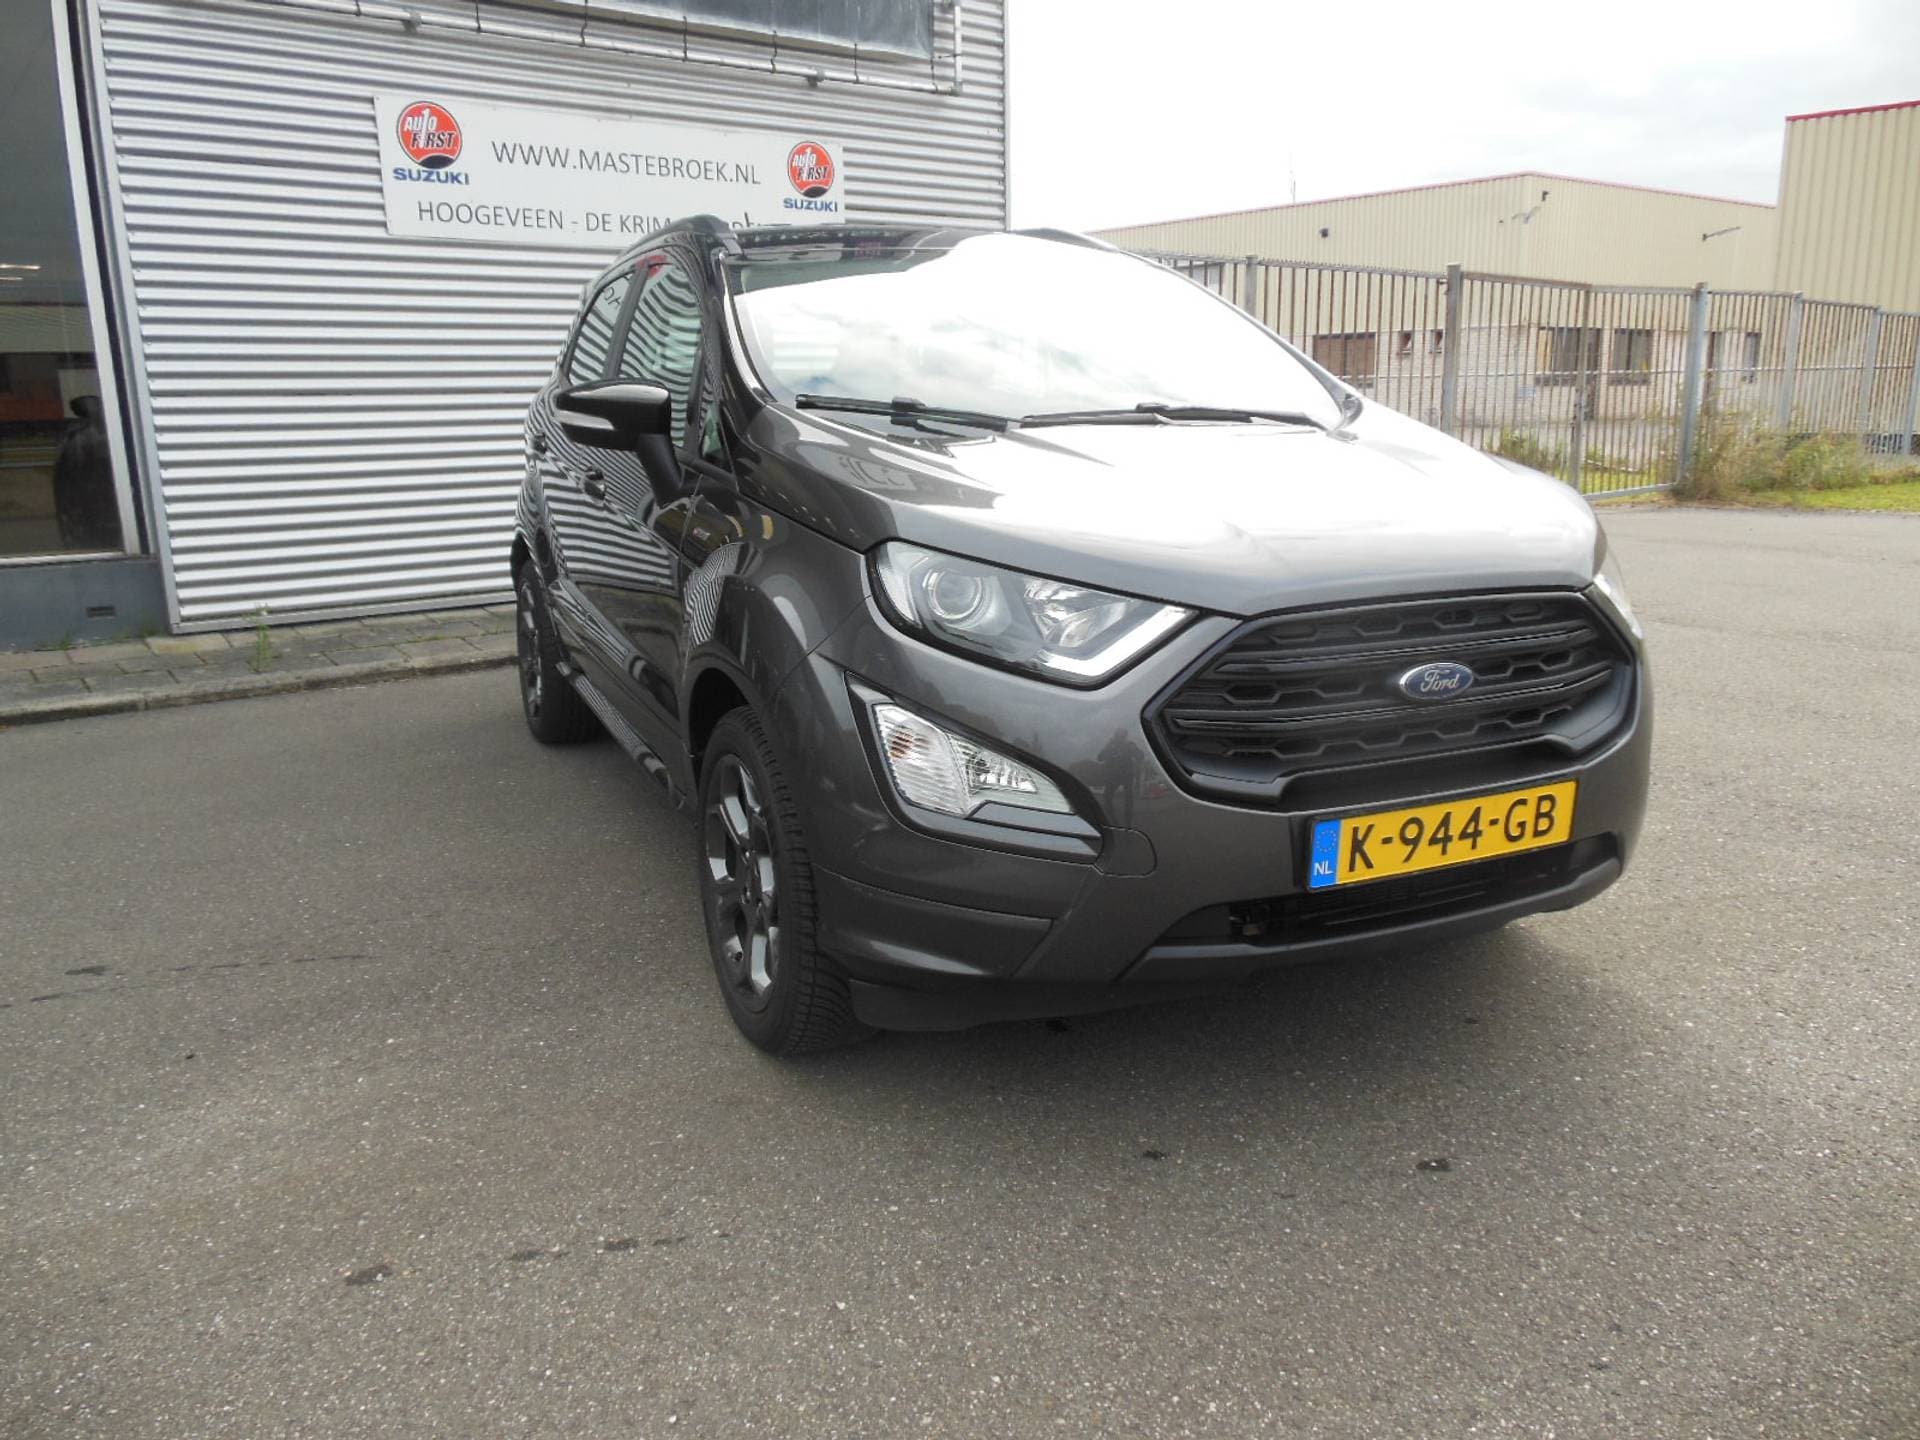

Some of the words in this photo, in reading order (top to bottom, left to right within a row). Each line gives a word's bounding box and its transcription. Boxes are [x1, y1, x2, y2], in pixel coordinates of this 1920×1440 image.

[491, 140, 762, 185] WWW.MASTEBROEK.NL
[392, 167, 470, 186] SUZUKI
[417, 200, 564, 230] HOOGEVEEN
[585, 212, 613, 232] DE
[783, 197, 838, 213] SUZUKI
[1420, 669, 1460, 692] Ford
[1348, 793, 1558, 873] K-944-GB
[1313, 860, 1334, 876] NL
